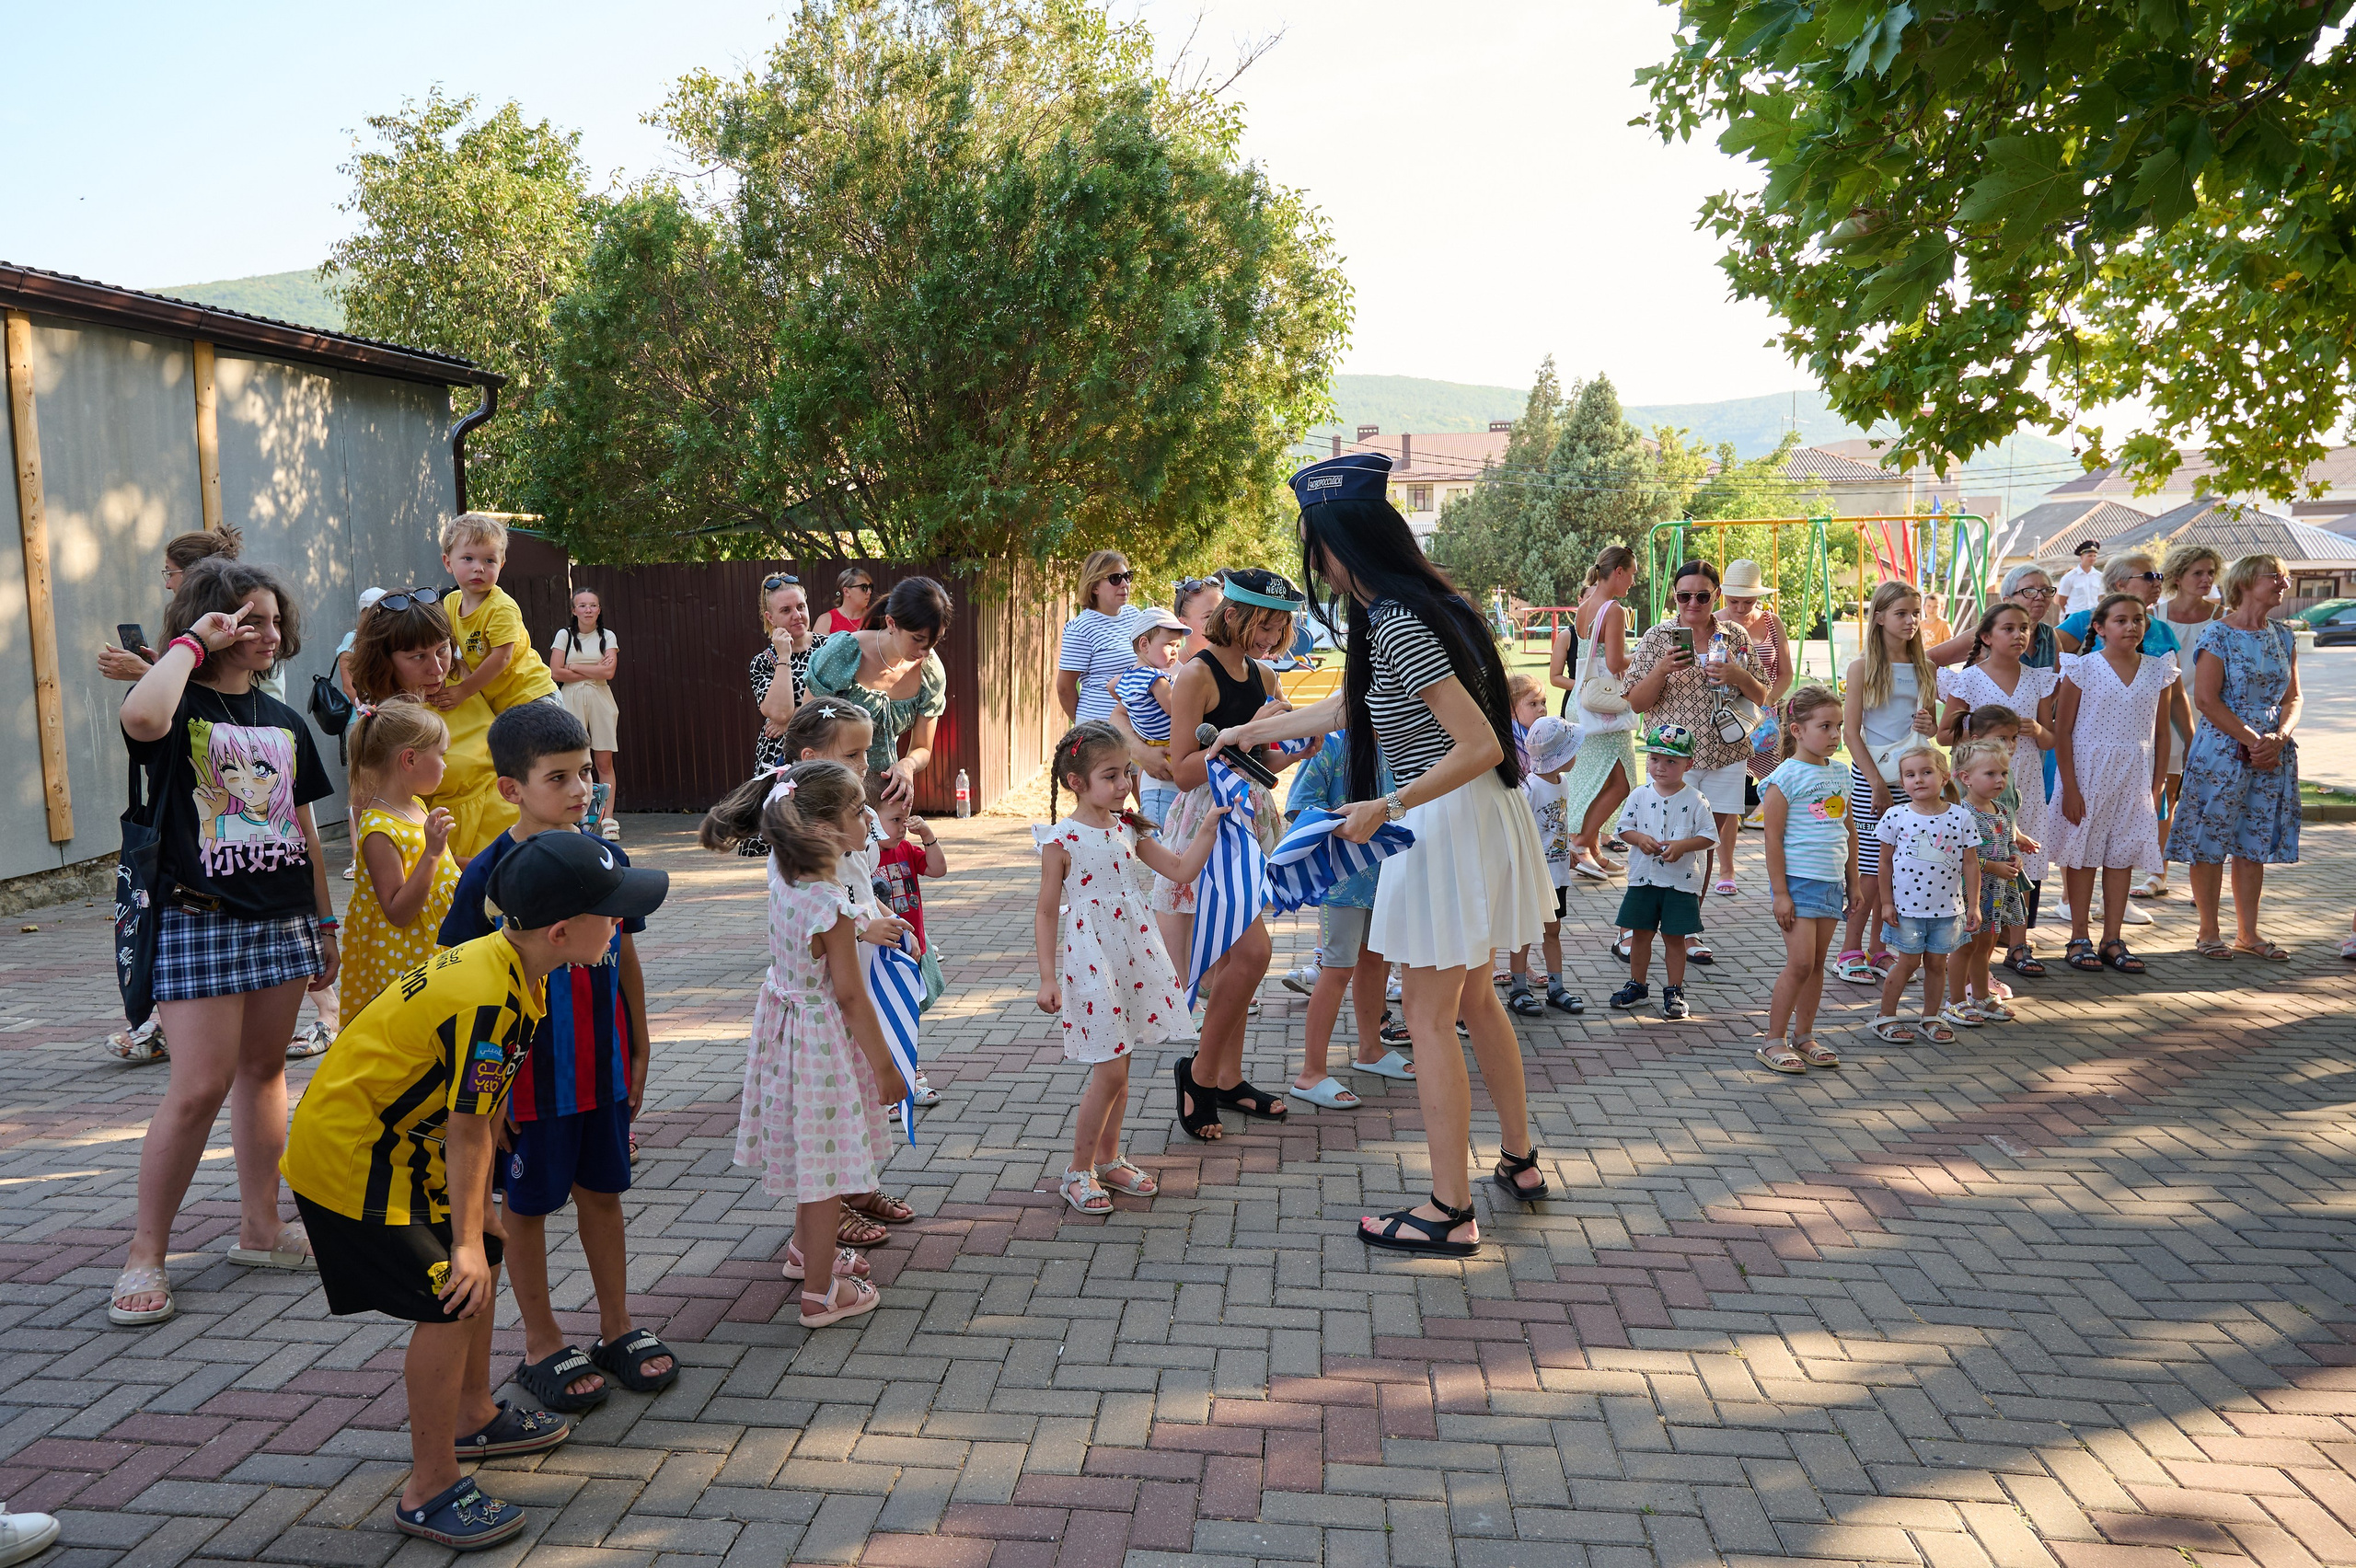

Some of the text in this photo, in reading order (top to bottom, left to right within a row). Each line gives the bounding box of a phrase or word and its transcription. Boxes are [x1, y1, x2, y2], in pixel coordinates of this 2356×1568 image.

[1265, 585, 1287, 595] NEVER
[1270, 577, 1284, 587] JUST
[626, 1337, 660, 1355] PUMA
[553, 1355, 590, 1376] PUMA
[423, 1529, 454, 1545] cross
